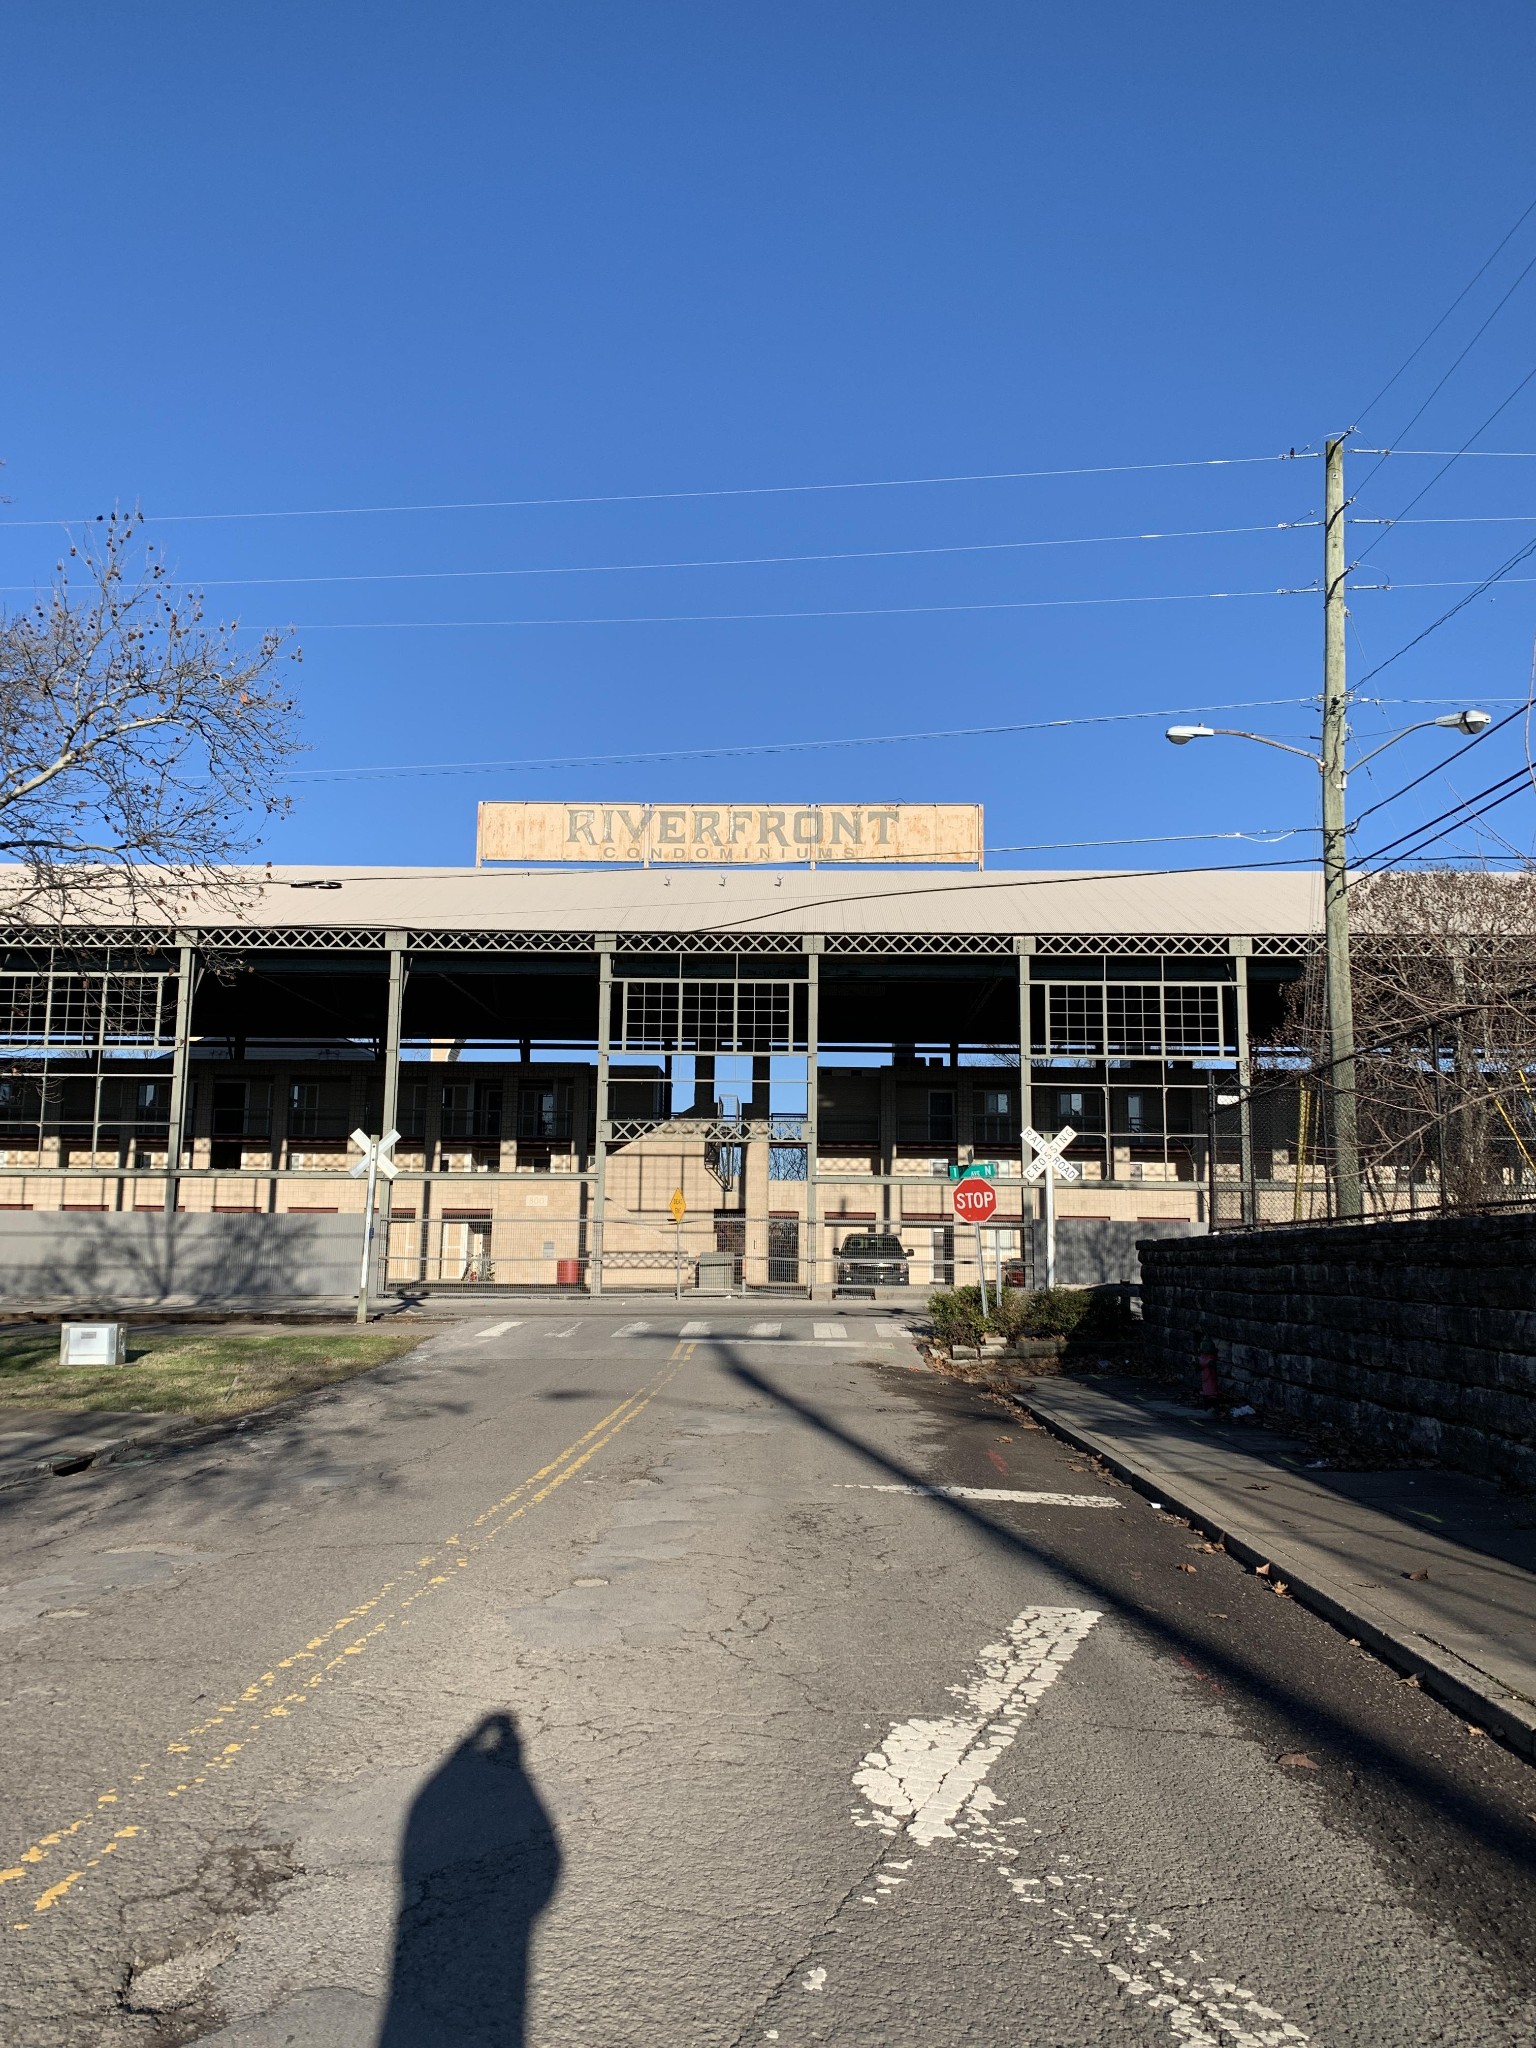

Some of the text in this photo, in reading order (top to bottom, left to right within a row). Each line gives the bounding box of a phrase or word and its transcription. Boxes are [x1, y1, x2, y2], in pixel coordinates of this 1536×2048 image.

[566, 809, 900, 847] RIVERFRONT
[603, 847, 854, 859] CONDOMINIUMS
[1026, 1129, 1074, 1178] CROSSING
[984, 1165, 992, 1176] N
[956, 1191, 994, 1210] STOP
